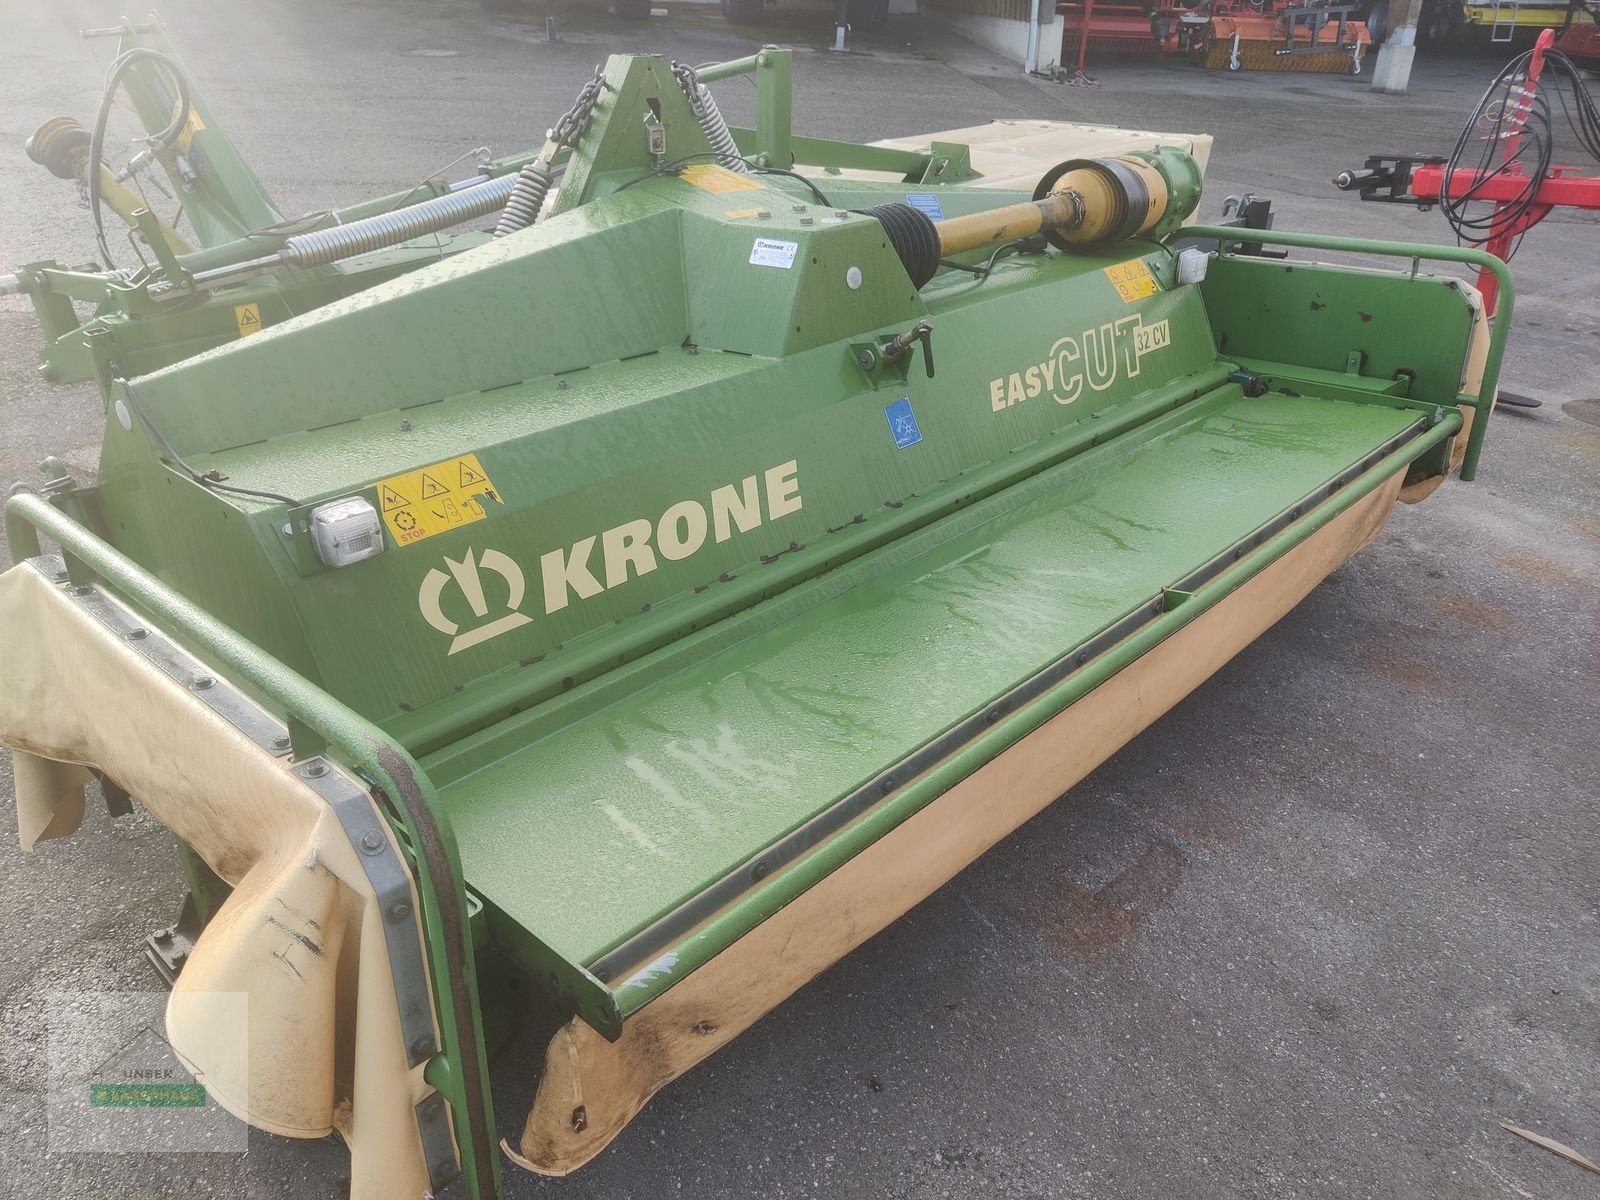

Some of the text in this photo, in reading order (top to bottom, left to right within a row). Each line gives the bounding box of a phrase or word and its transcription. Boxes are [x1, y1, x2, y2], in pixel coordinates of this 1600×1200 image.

[1136, 330, 1151, 351] 32
[1153, 323, 1166, 345] CV
[400, 528, 426, 542] STOP
[540, 459, 803, 615] KRONE
